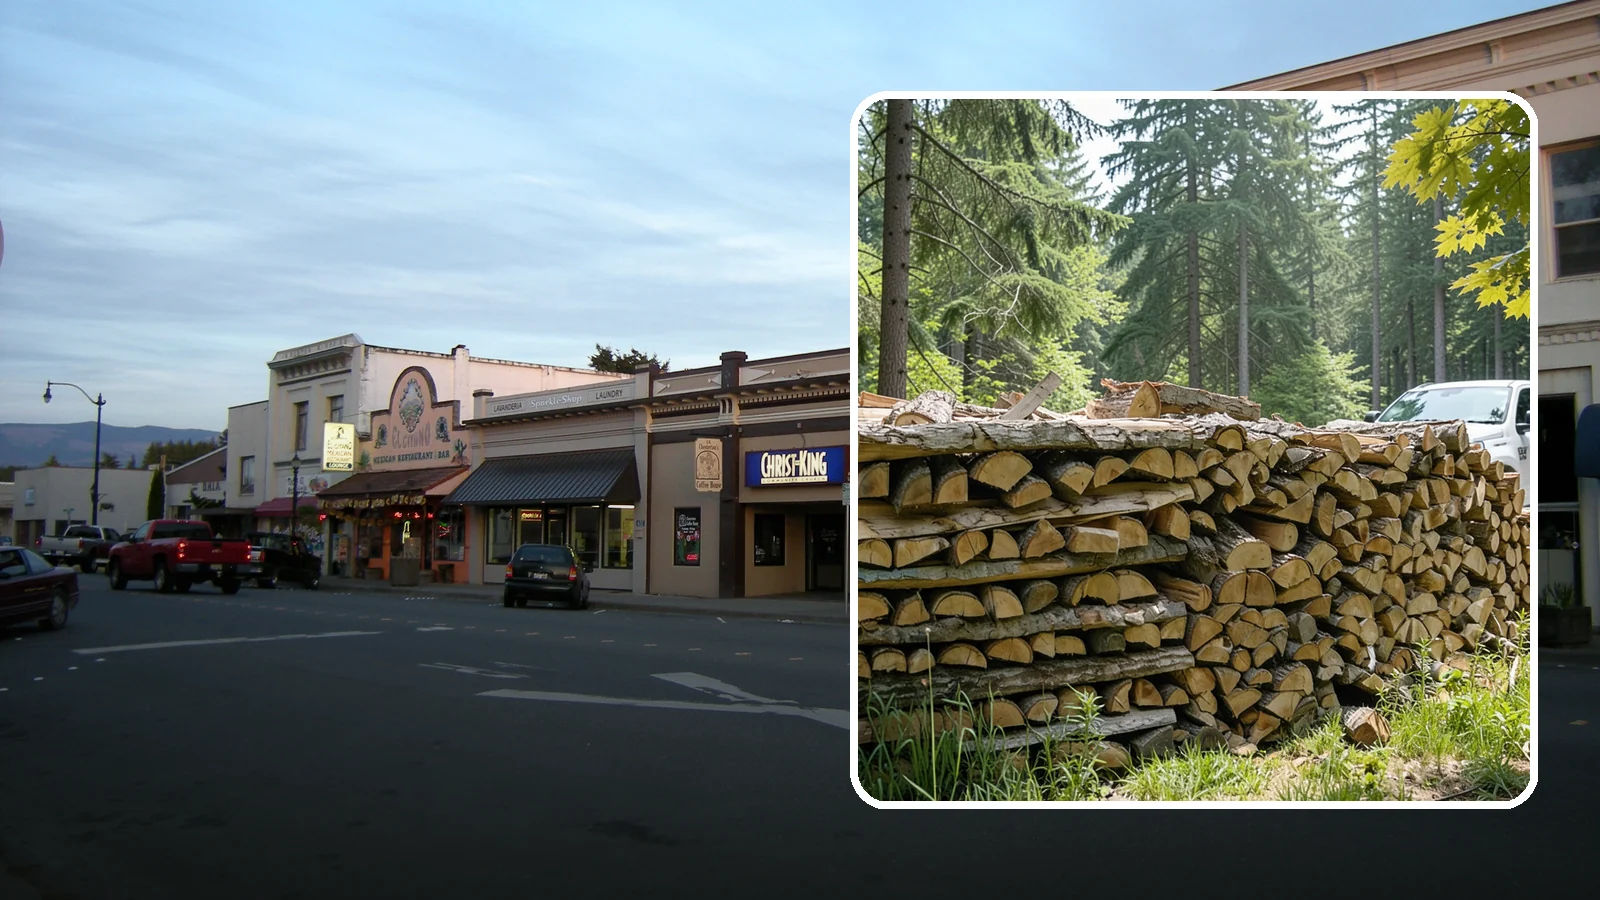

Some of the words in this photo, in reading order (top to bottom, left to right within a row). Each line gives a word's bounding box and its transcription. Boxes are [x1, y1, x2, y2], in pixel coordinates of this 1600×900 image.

[562, 395, 582, 404] Shop
[595, 389, 624, 400] LAUNDRY
[493, 402, 523, 412] LAVANDERIA
[373, 455, 396, 464] MEXICAN
[397, 451, 433, 462] RESTAURANT
[437, 450, 450, 459] BAR
[799, 450, 827, 476] KING
[696, 480, 709, 489] Coffee
[710, 480, 722, 489] House
